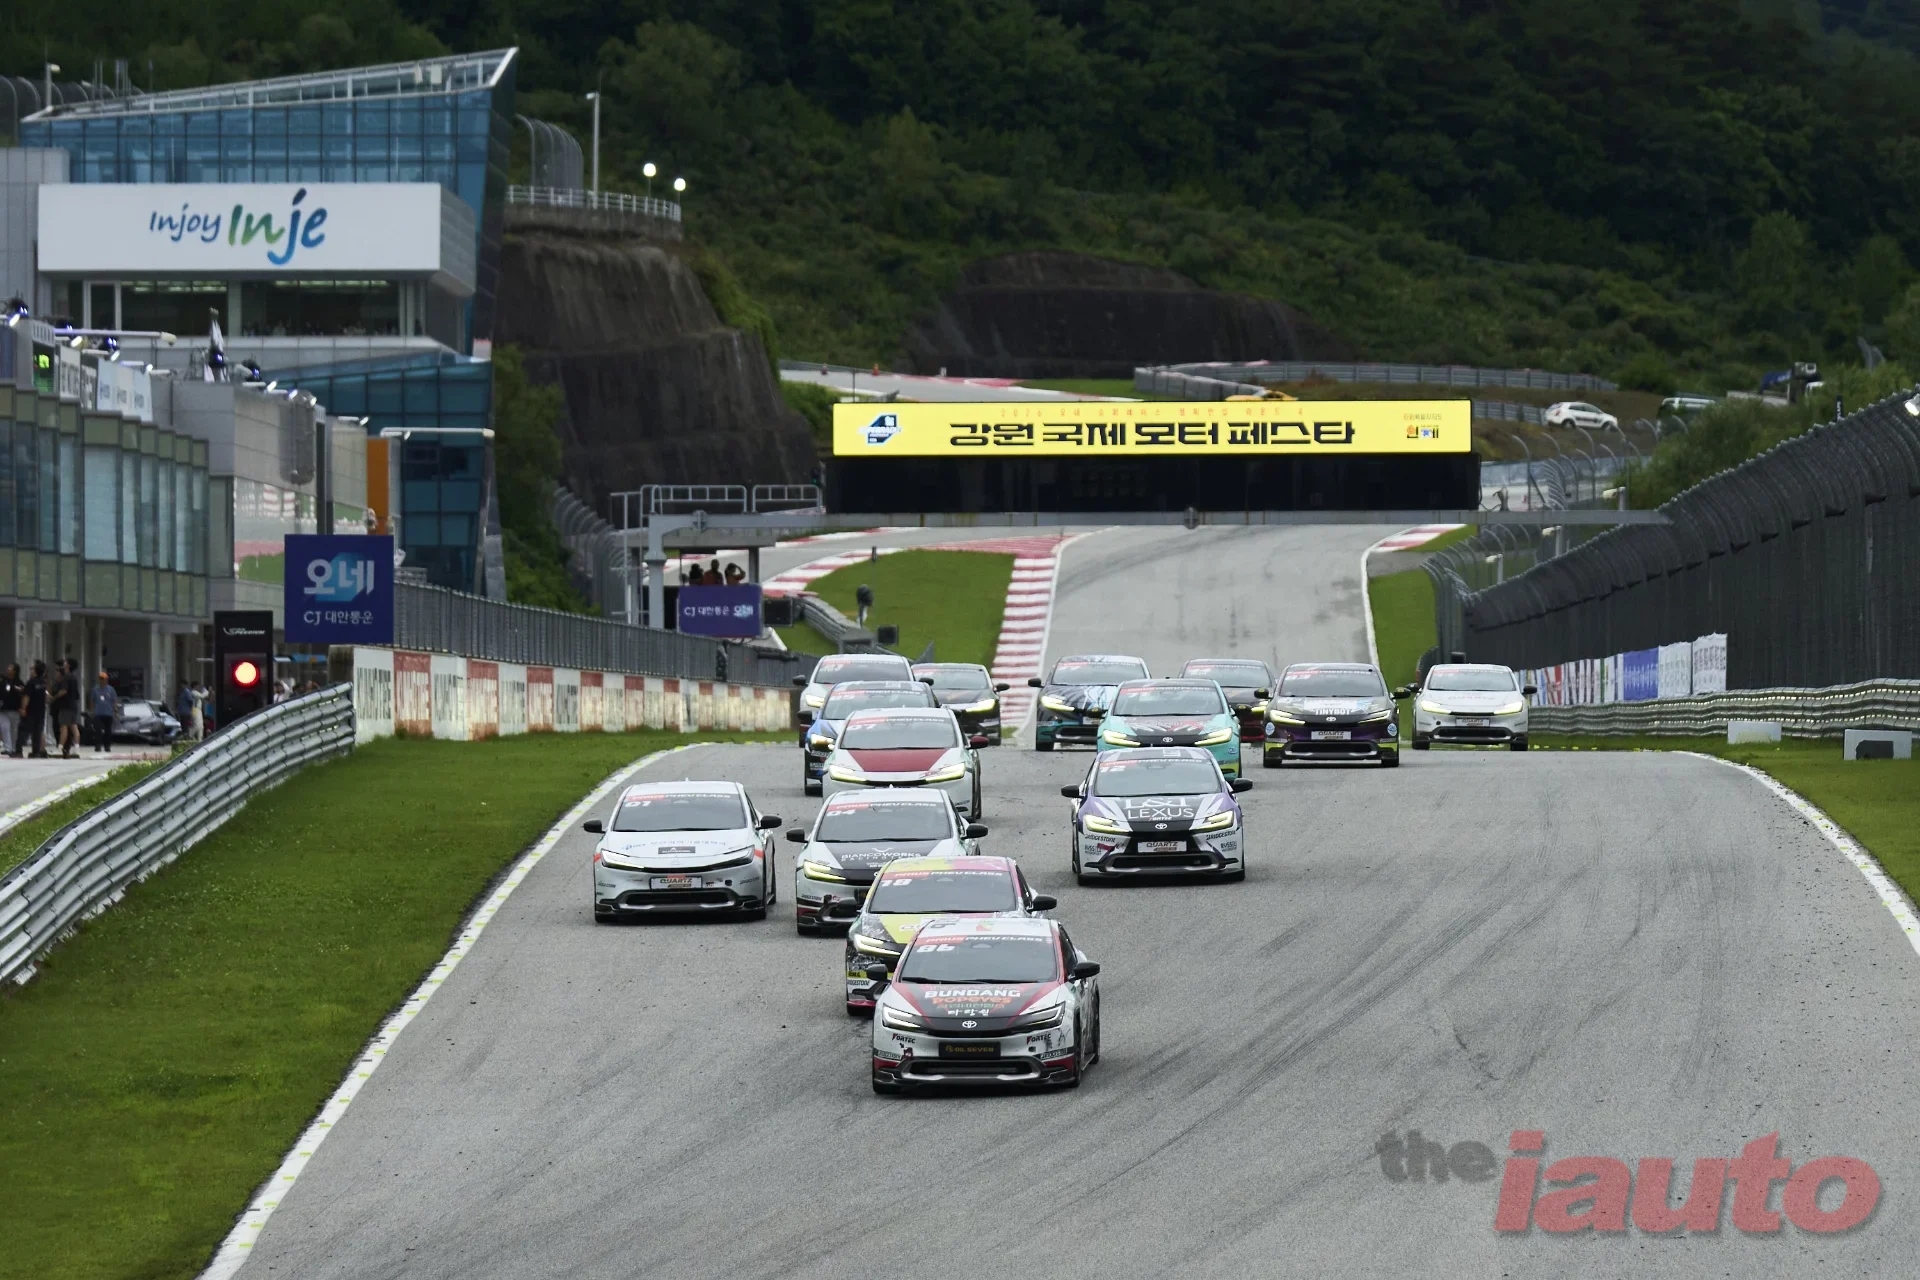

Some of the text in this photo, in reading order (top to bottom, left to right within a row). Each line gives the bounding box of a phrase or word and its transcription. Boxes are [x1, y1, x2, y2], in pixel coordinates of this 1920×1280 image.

[149, 187, 328, 266] Injoy Inje
[949, 421, 1355, 446] 강원 국제 모터 페스타
[303, 558, 375, 596] 오네
[303, 610, 374, 626] CJ 대한통운
[684, 606, 696, 617] CJ
[697, 606, 730, 617] 대한통운
[625, 800, 652, 808] 01
[1127, 807, 1195, 819] LEXUS
[924, 989, 1021, 998] BUNDANG
